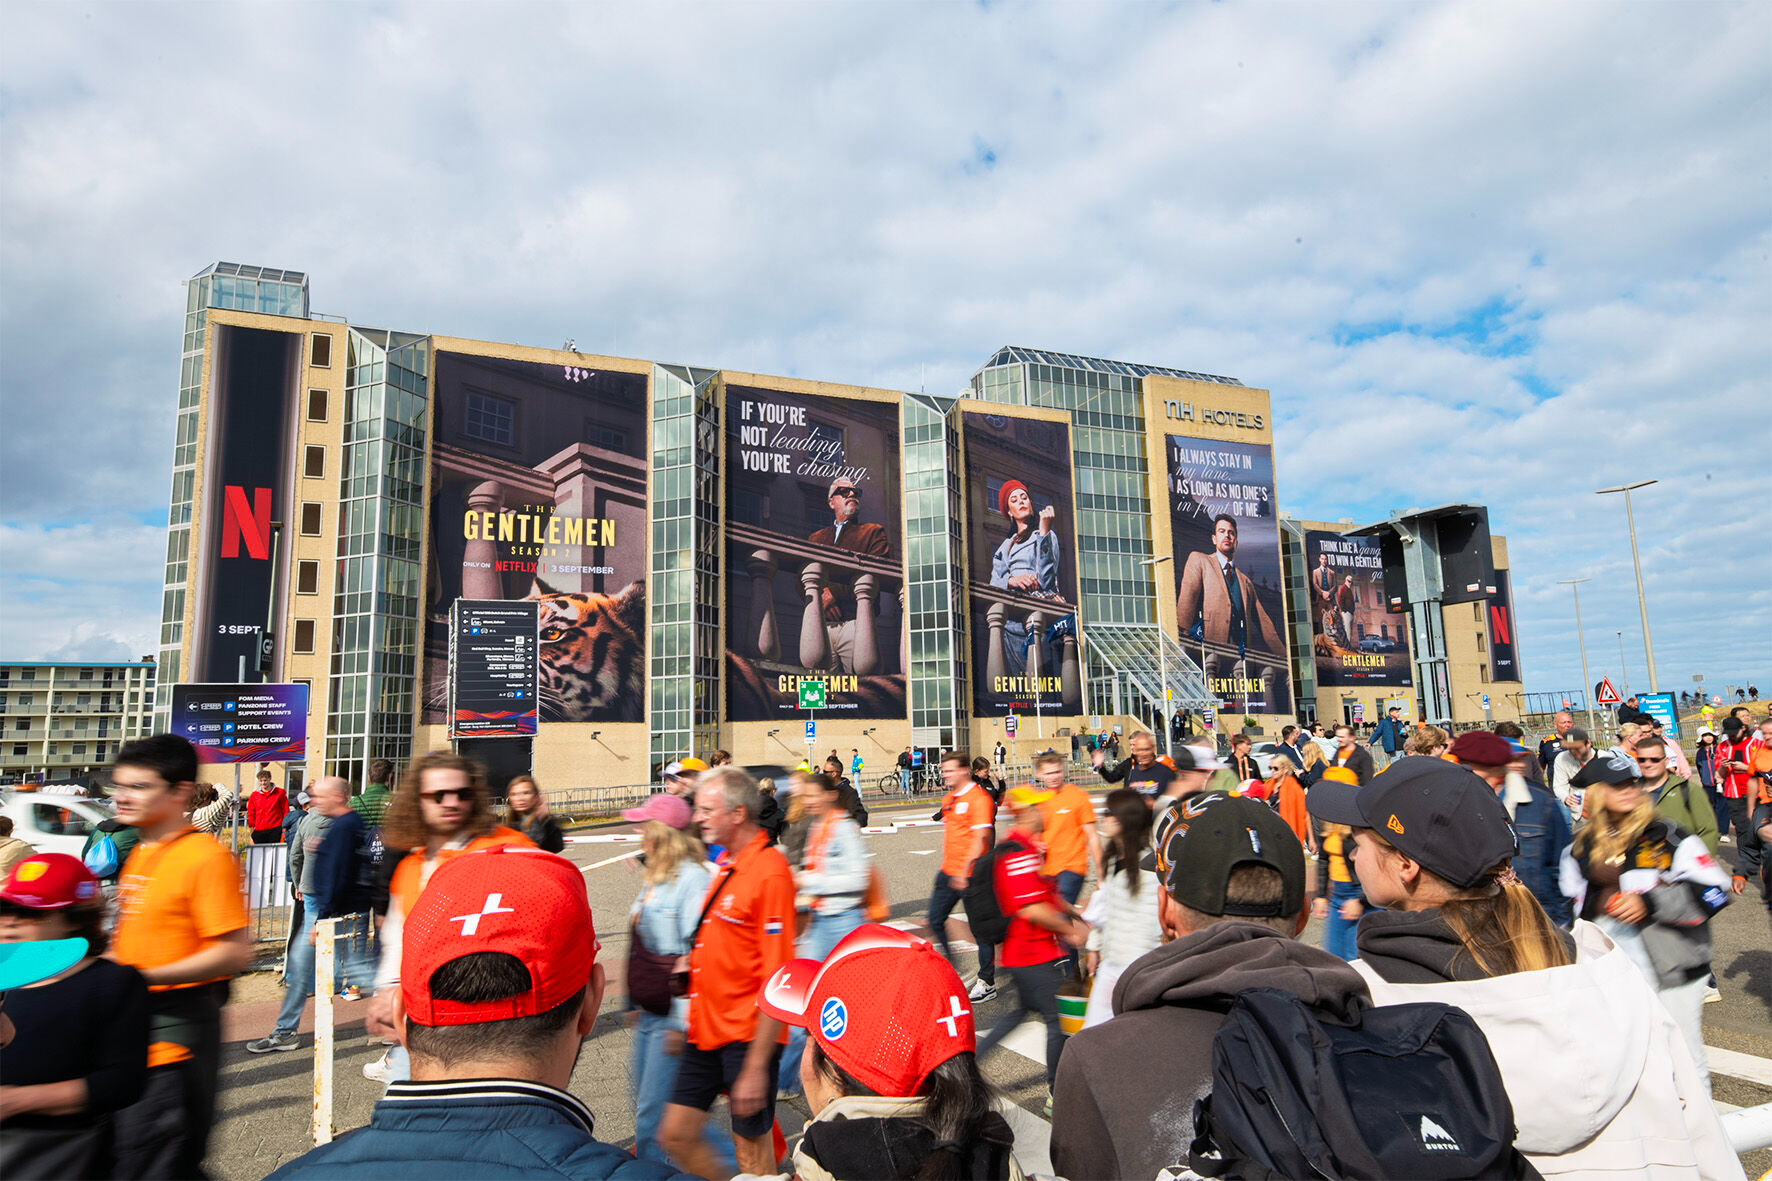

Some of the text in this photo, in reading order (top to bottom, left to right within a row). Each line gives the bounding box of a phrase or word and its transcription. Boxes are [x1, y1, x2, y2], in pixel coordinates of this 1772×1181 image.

[741, 400, 806, 426] IF YOU'RE
[1202, 408, 1264, 429] HOTELS
[741, 423, 845, 460] NOT leading,
[741, 450, 870, 486] YOU'RE chasing.
[1174, 447, 1252, 470] I ALWAYS STAY IN
[1175, 465, 1197, 482] my
[1177, 479, 1268, 502] AS LONG AS NO ONE'S
[524, 504, 556, 513] THE
[1177, 495, 1262, 519] in front OF ME.
[220, 485, 272, 560] N
[464, 510, 615, 547] GENTLEMEN
[511, 546, 556, 557] SEASON
[1320, 540, 1382, 559] THINK LIKE A gang
[495, 560, 537, 574] NETFLIX
[551, 564, 557, 573] 3
[558, 565, 615, 575] SEPTEMBER
[1327, 554, 1383, 569] TO WIN A GENTLEM
[1370, 570, 1384, 583] ga
[218, 625, 260, 634] 3 SEPT
[1490, 606, 1510, 645] N
[1343, 654, 1386, 667] GENTLEMEN
[994, 675, 1062, 693] GENTLEMEN
[1208, 678, 1266, 693] GENTLEMEN
